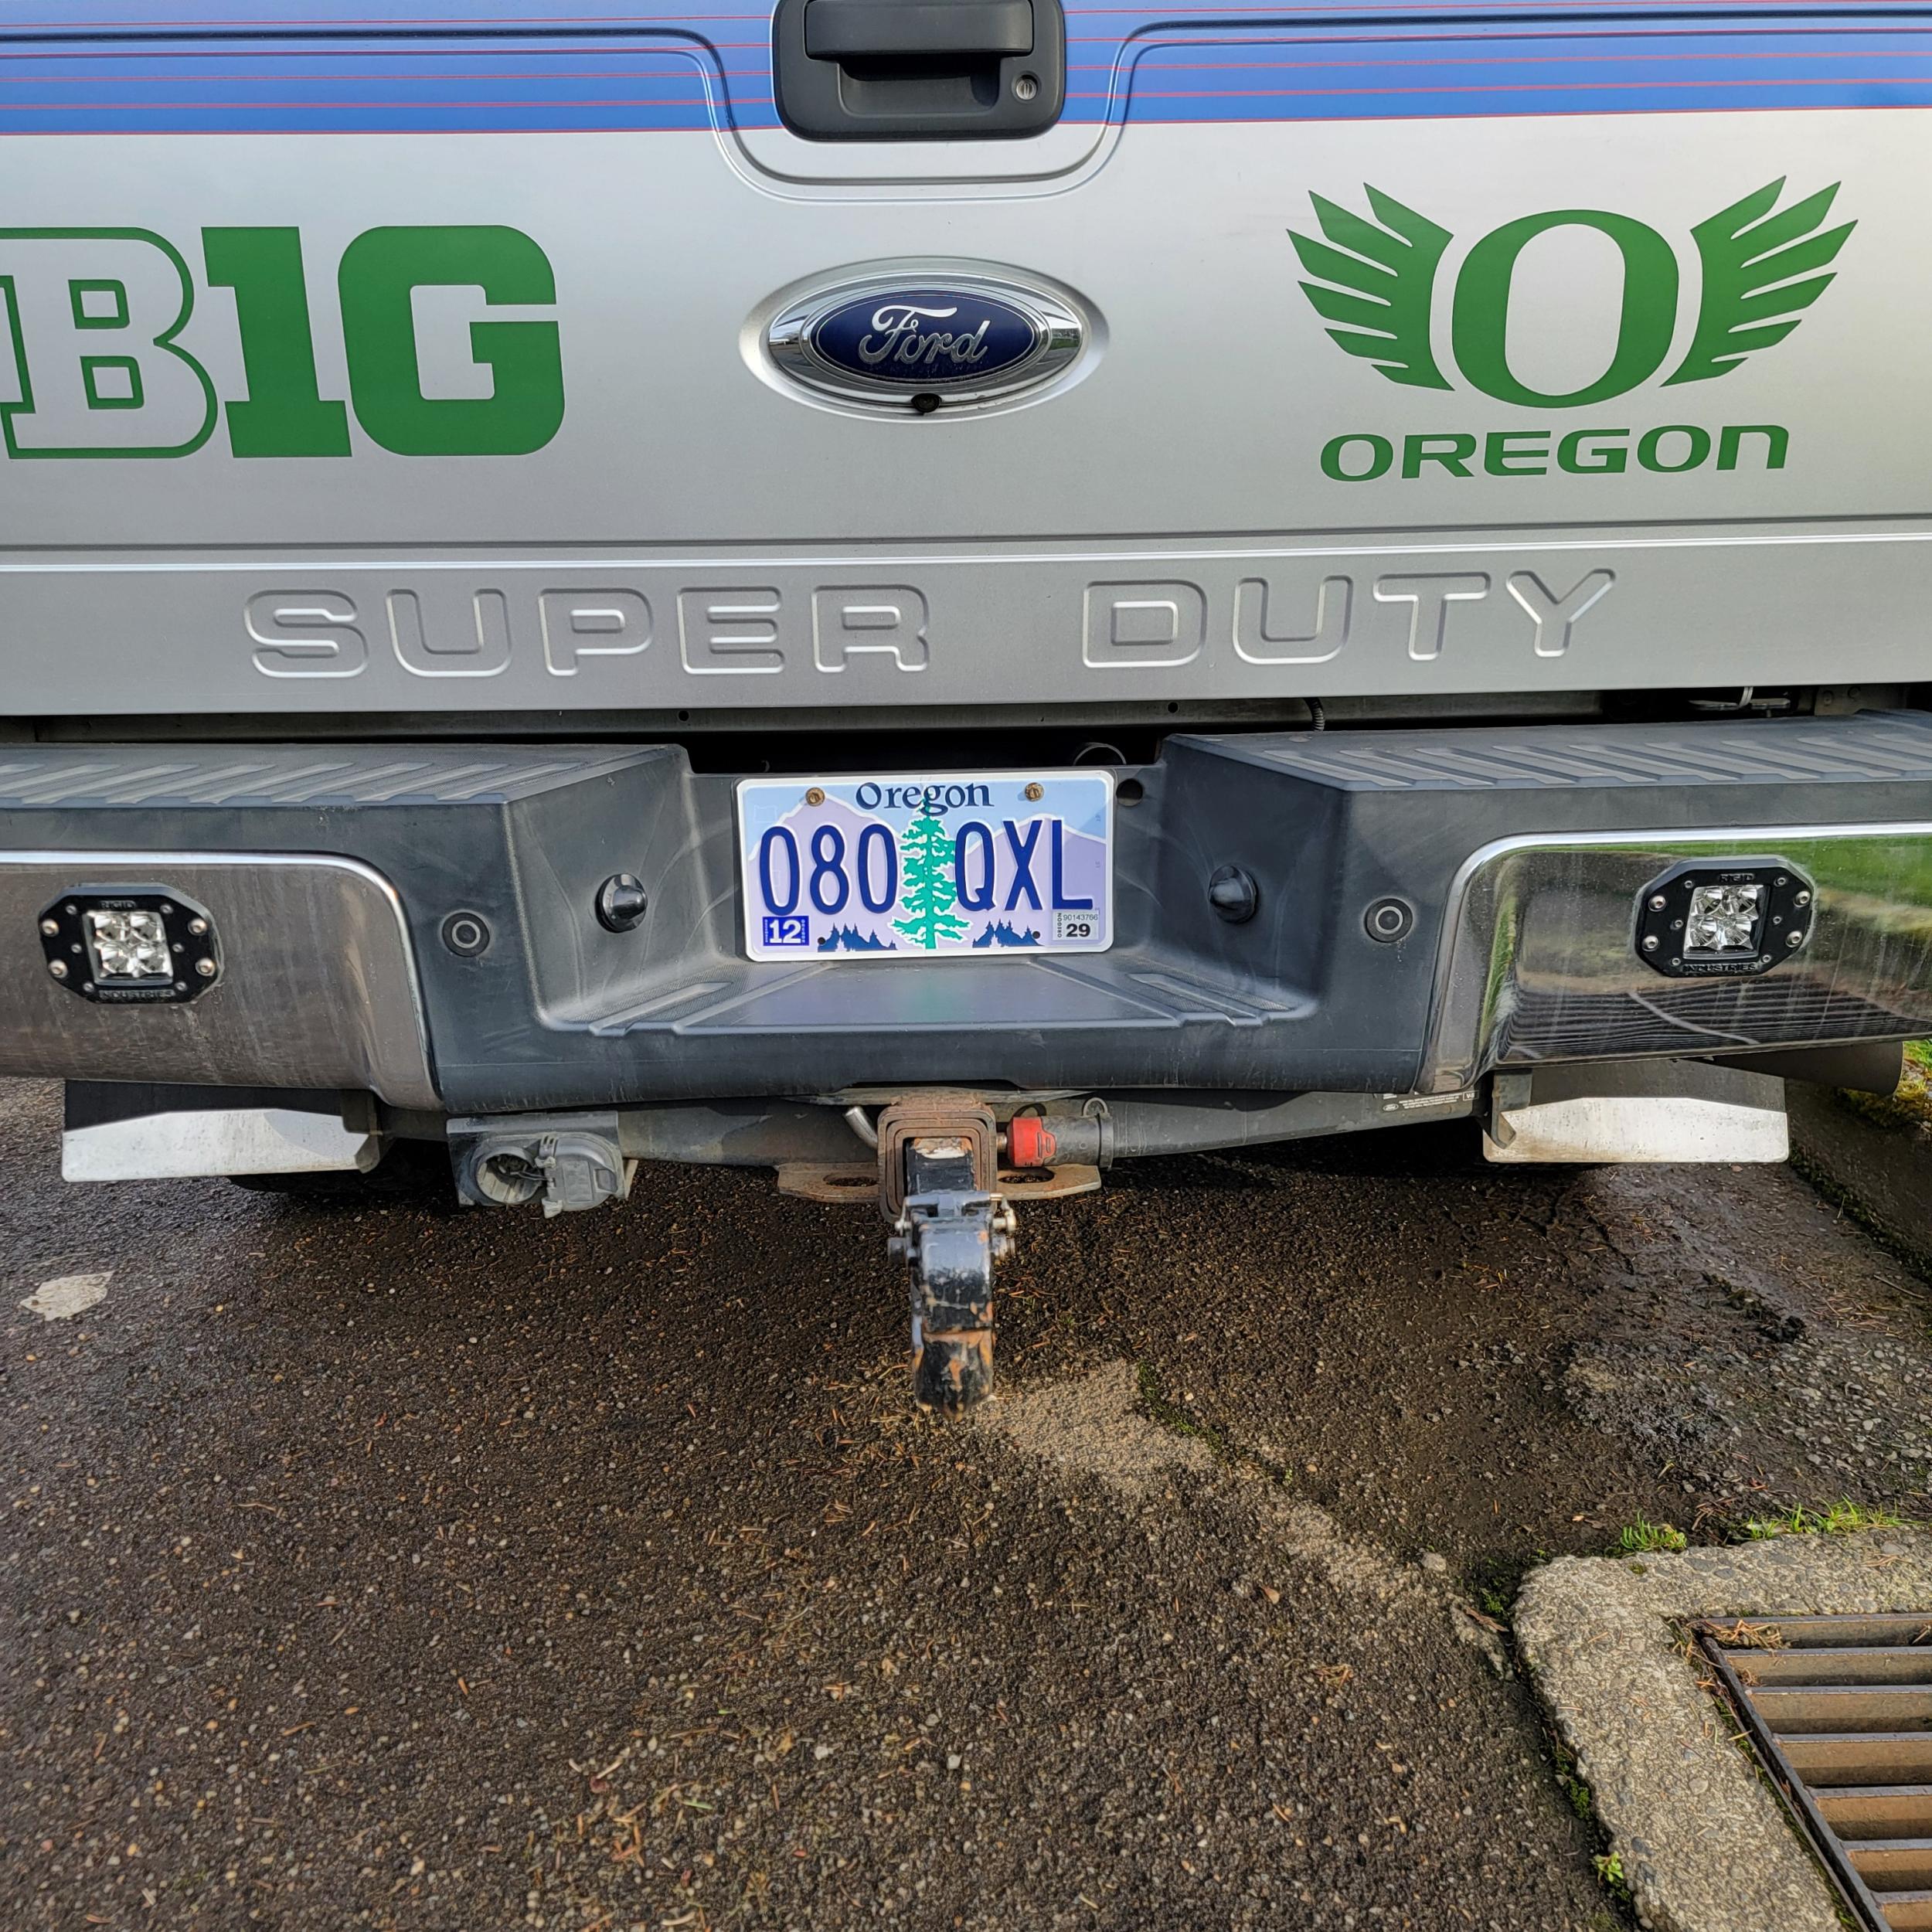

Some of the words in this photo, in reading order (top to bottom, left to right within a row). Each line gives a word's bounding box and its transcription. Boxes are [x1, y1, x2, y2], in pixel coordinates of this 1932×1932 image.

[858, 304, 991, 364] Ford
[244, 584, 930, 679] SUPER
[1083, 568, 1617, 669] DUTY
[855, 782, 995, 816] Oregon
[760, 823, 898, 916] 080
[954, 819, 1093, 911] QXL
[769, 919, 801, 943] 12
[1066, 923, 1090, 937] 29
